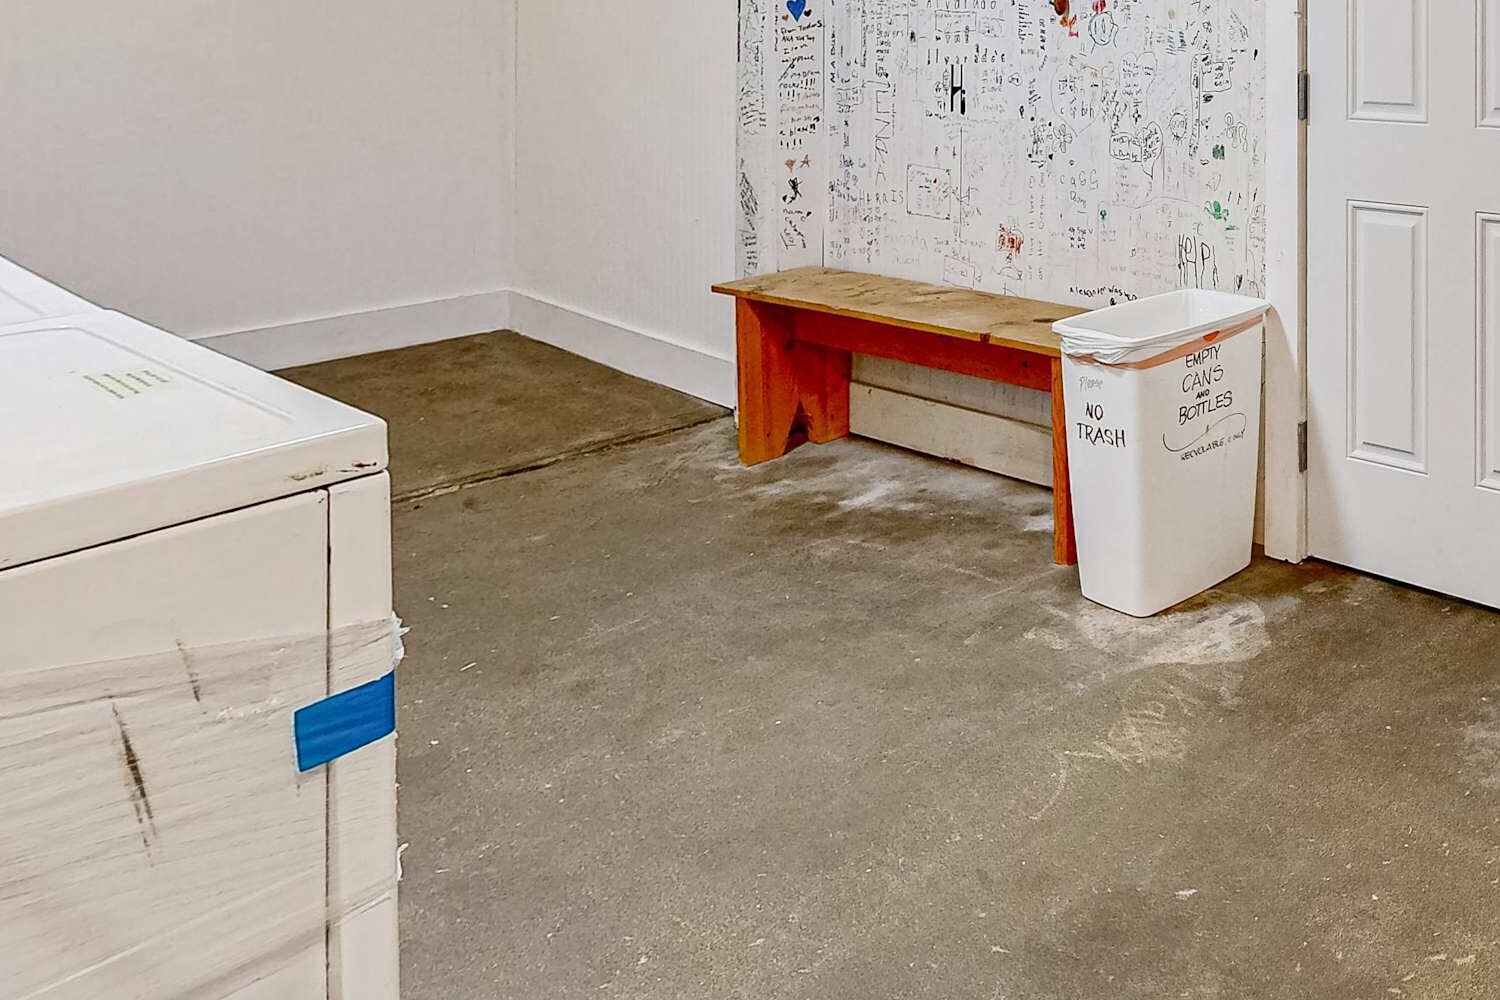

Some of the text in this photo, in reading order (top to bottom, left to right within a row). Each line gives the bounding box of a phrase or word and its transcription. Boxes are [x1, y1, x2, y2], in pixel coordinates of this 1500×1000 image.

[1185, 344, 1222, 369] EMPTY
[1182, 364, 1224, 393] CANS
[1195, 388, 1210, 400] AND
[1085, 401, 1104, 421] NO
[1179, 390, 1233, 426] BOTTLES
[1076, 422, 1126, 449] TRASH
